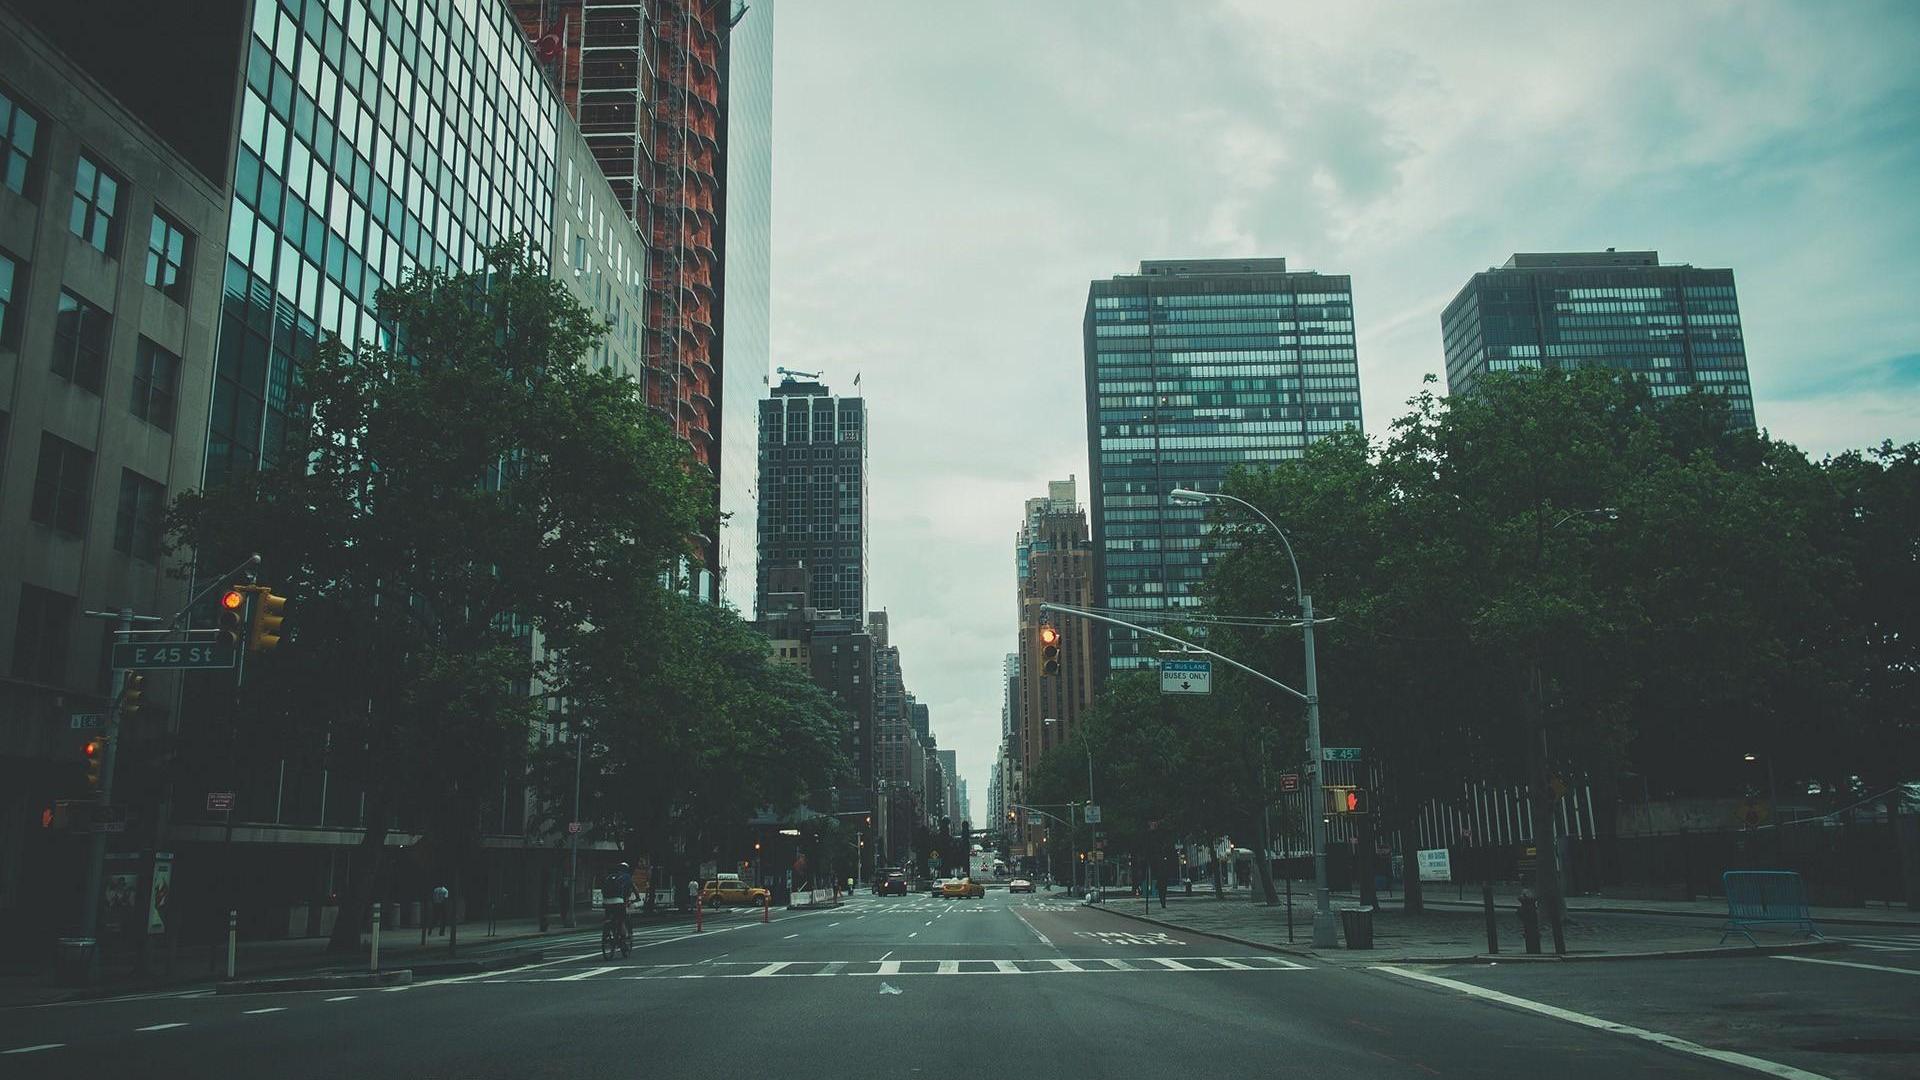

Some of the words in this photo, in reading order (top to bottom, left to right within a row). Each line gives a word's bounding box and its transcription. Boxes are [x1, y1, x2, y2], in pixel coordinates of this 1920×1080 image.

[135, 648, 147, 663] E
[153, 648, 181, 662] 45
[189, 647, 212, 662] St
[1164, 672, 1187, 680] BUSES
[1189, 672, 1208, 680] ONLY
[1339, 749, 1353, 759] 45
